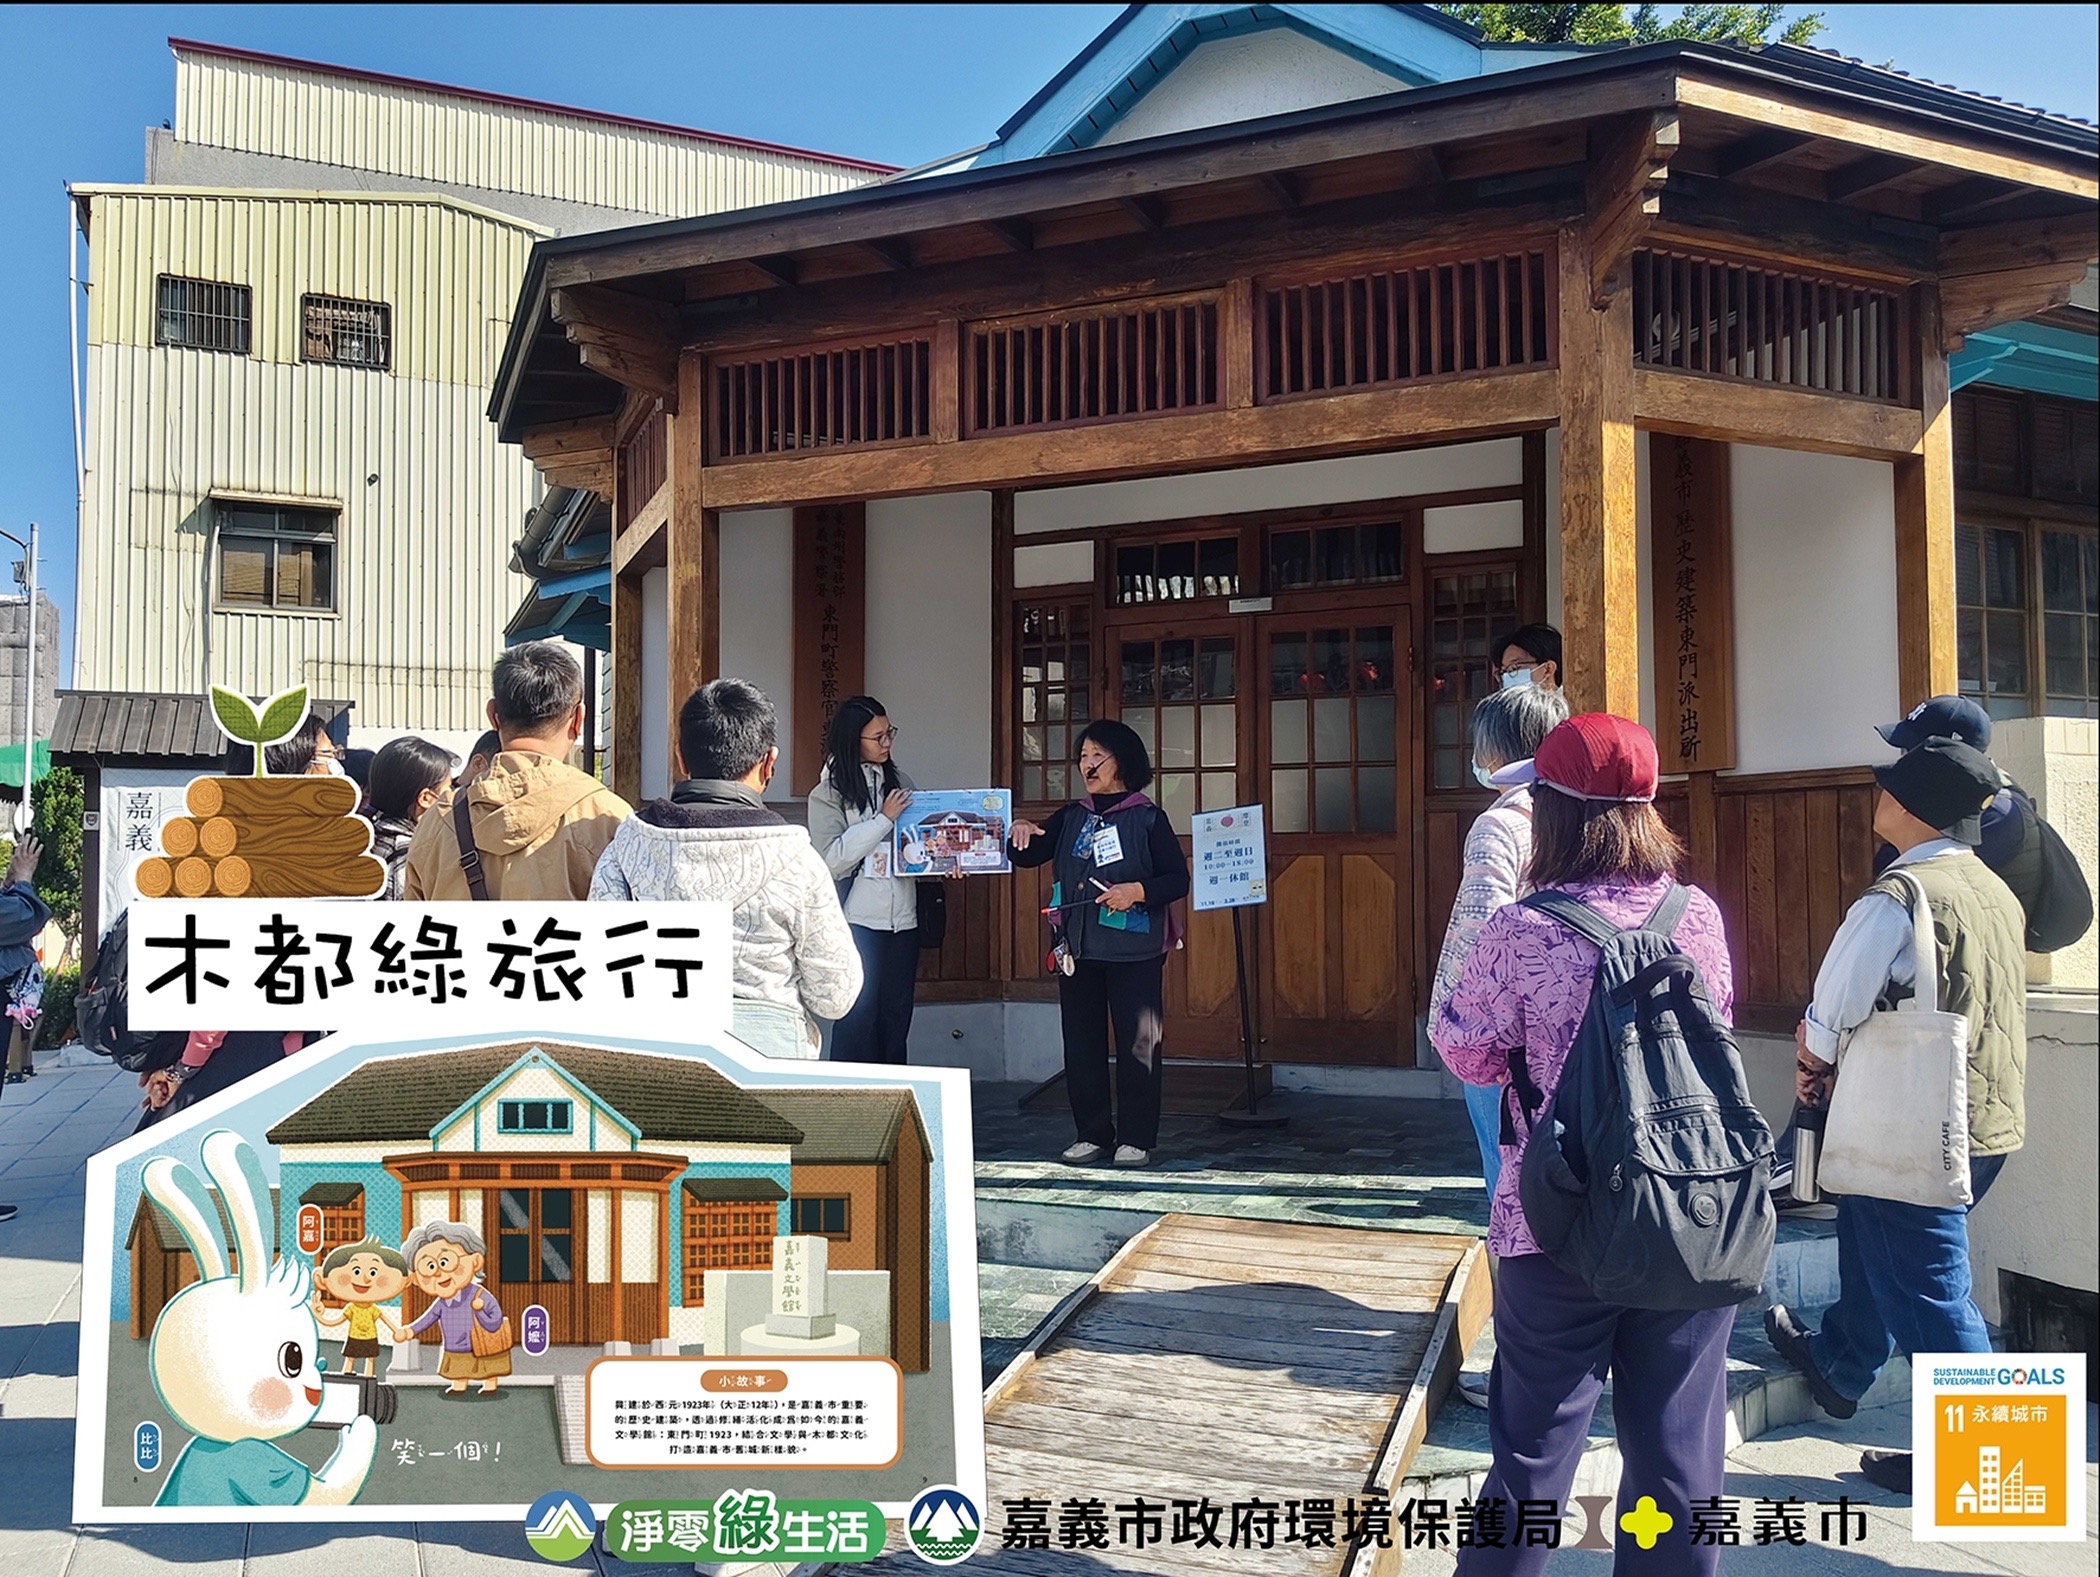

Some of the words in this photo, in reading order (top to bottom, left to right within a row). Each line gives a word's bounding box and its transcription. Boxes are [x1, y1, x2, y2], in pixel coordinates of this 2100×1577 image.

[125, 792, 153, 852] 嘉義
[1942, 1121, 1950, 1147] CAFE
[1943, 1148, 1952, 1171] CITY
